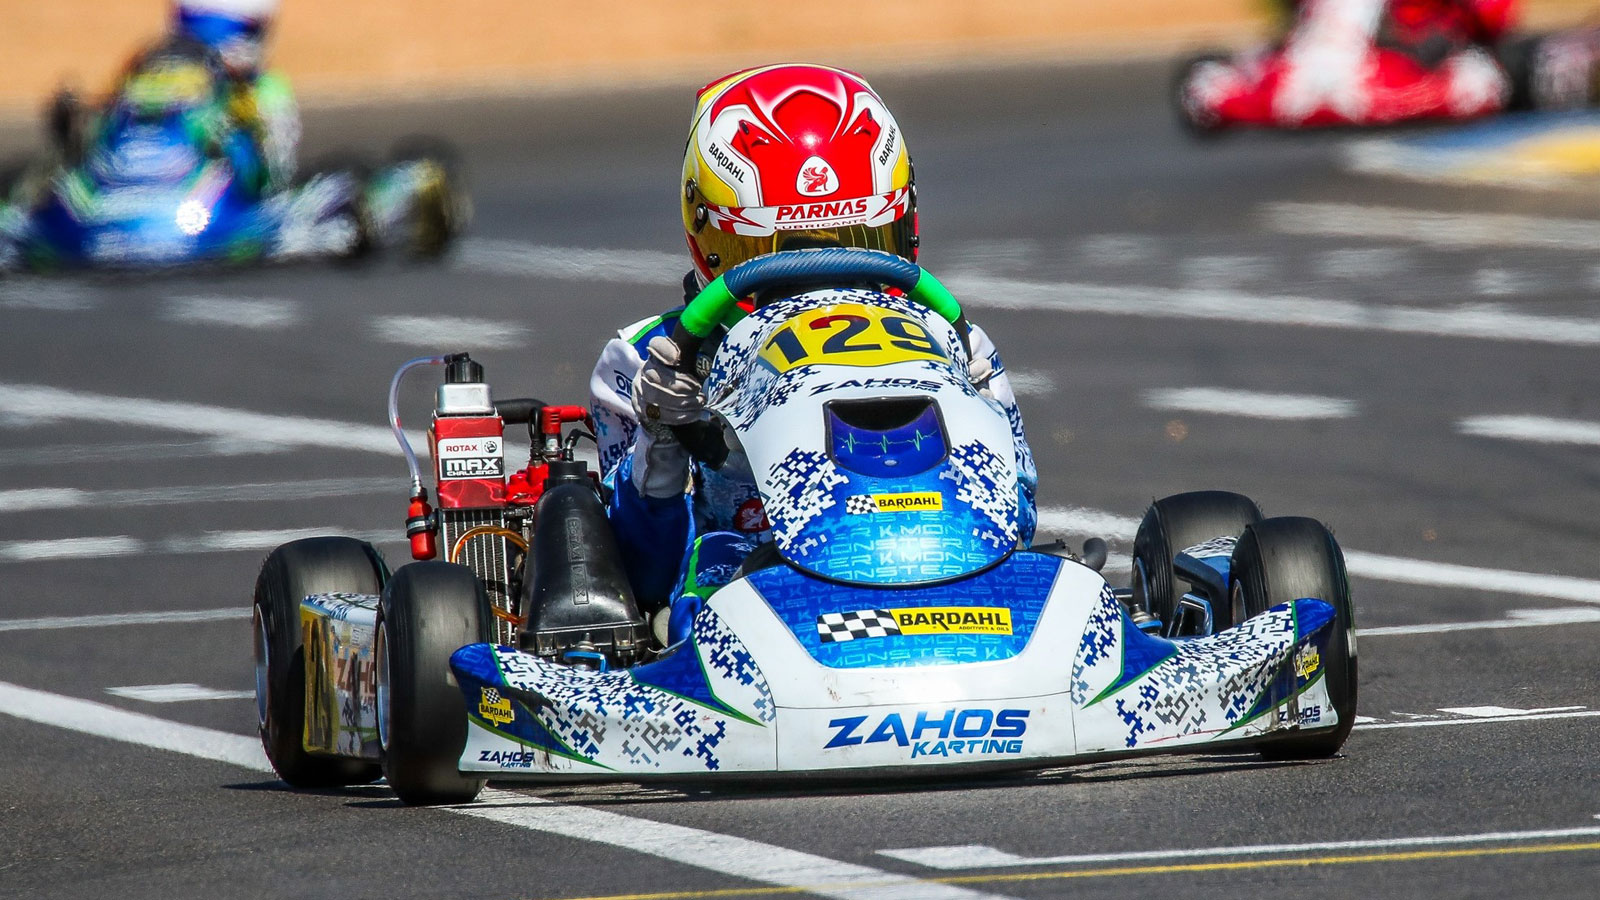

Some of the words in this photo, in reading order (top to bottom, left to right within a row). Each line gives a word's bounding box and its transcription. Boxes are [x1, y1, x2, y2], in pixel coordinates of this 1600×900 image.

[878, 125, 896, 166] BARDAHL
[708, 142, 745, 183] BARDAHL
[776, 199, 867, 220] PARNAS
[774, 219, 867, 230] LUBRICANTS
[765, 313, 949, 364] 129
[808, 378, 943, 397] ZAHOS
[446, 458, 498, 471] MAX
[879, 497, 940, 509] BARDAHL
[821, 537, 963, 556] ONSTER
[900, 549, 988, 564] MONS
[899, 612, 1008, 630] BARDAHL
[337, 658, 375, 696] ZAHO
[480, 704, 513, 719] BARDAHL
[1279, 705, 1321, 721] ZHOS
[823, 708, 1031, 750] ZAHOS
[478, 750, 535, 763] ZAHOS
[911, 739, 1023, 759] KARTING
